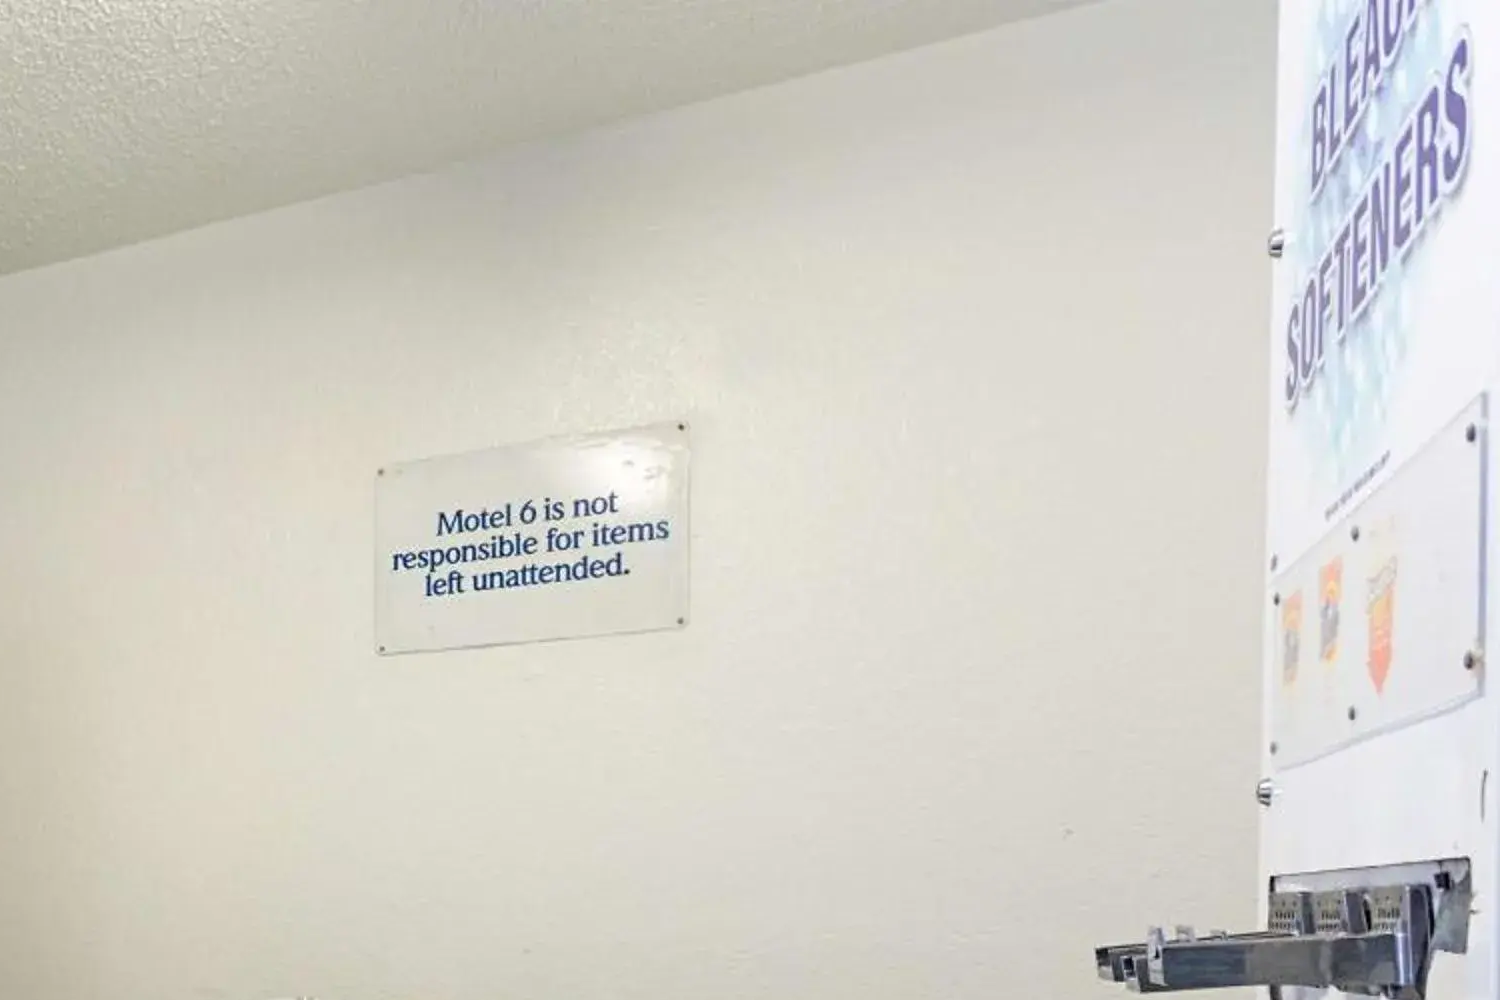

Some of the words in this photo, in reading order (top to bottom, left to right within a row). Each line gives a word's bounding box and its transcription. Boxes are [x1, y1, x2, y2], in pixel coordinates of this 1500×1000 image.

[1311, 0, 1416, 194] BLEA
[1286, 38, 1468, 401] SOFTENERS
[436, 503, 512, 537] Motel
[519, 499, 537, 525] 6
[544, 496, 564, 522] is
[573, 491, 619, 518] not
[392, 534, 538, 572] responsible
[546, 526, 585, 553] for
[592, 519, 670, 547] items
[424, 571, 464, 598] left
[473, 551, 631, 592] unattended.
